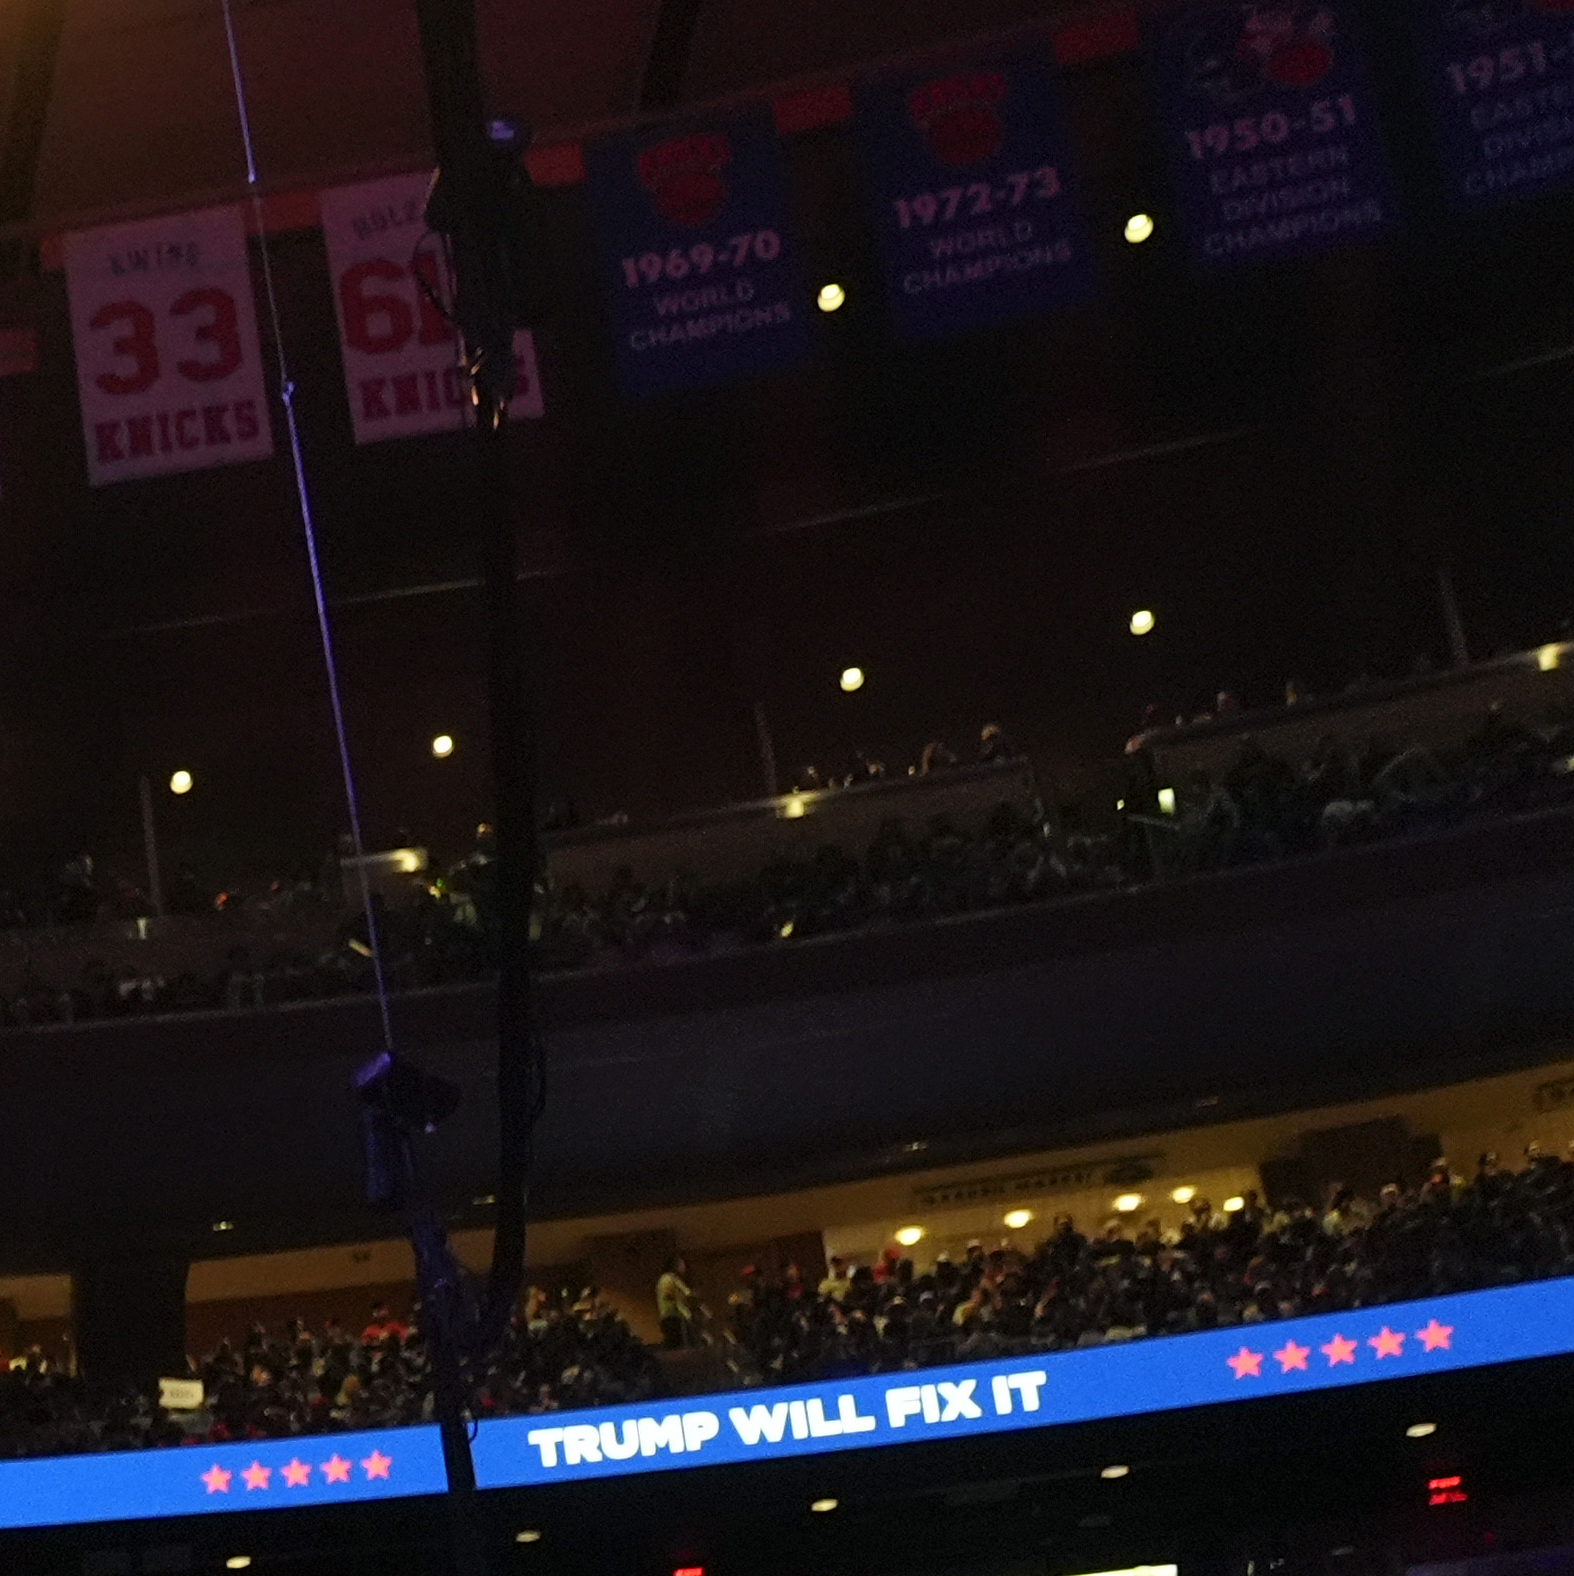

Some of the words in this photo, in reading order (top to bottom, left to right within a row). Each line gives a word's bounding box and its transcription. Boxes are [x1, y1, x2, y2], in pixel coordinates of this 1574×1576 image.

[1445, 33, 1574, 95] 1951-
[1184, 95, 1359, 160] 1950-51
[1471, 83, 1574, 131] EASTE
[892, 164, 1062, 230] 1972-73
[1209, 144, 1349, 195] EASTERN
[1464, 147, 1574, 196] CHAMP
[1202, 198, 1382, 256] CHAMPIONS
[1220, 176, 1351, 223] DIVISION
[620, 228, 781, 289] 1969-70
[902, 238, 1072, 296] CHAMPIONS
[927, 219, 1034, 261] WORLD
[628, 301, 792, 351] CHAMPIONS
[653, 276, 756, 318] WORLD
[89, 288, 242, 396] 33
[94, 401, 260, 465] KNICKS
[527, 1411, 719, 1468] TRUMP
[728, 1394, 875, 1444] WILL
[885, 1379, 981, 1428] FIX
[991, 1370, 1046, 1414] IT
